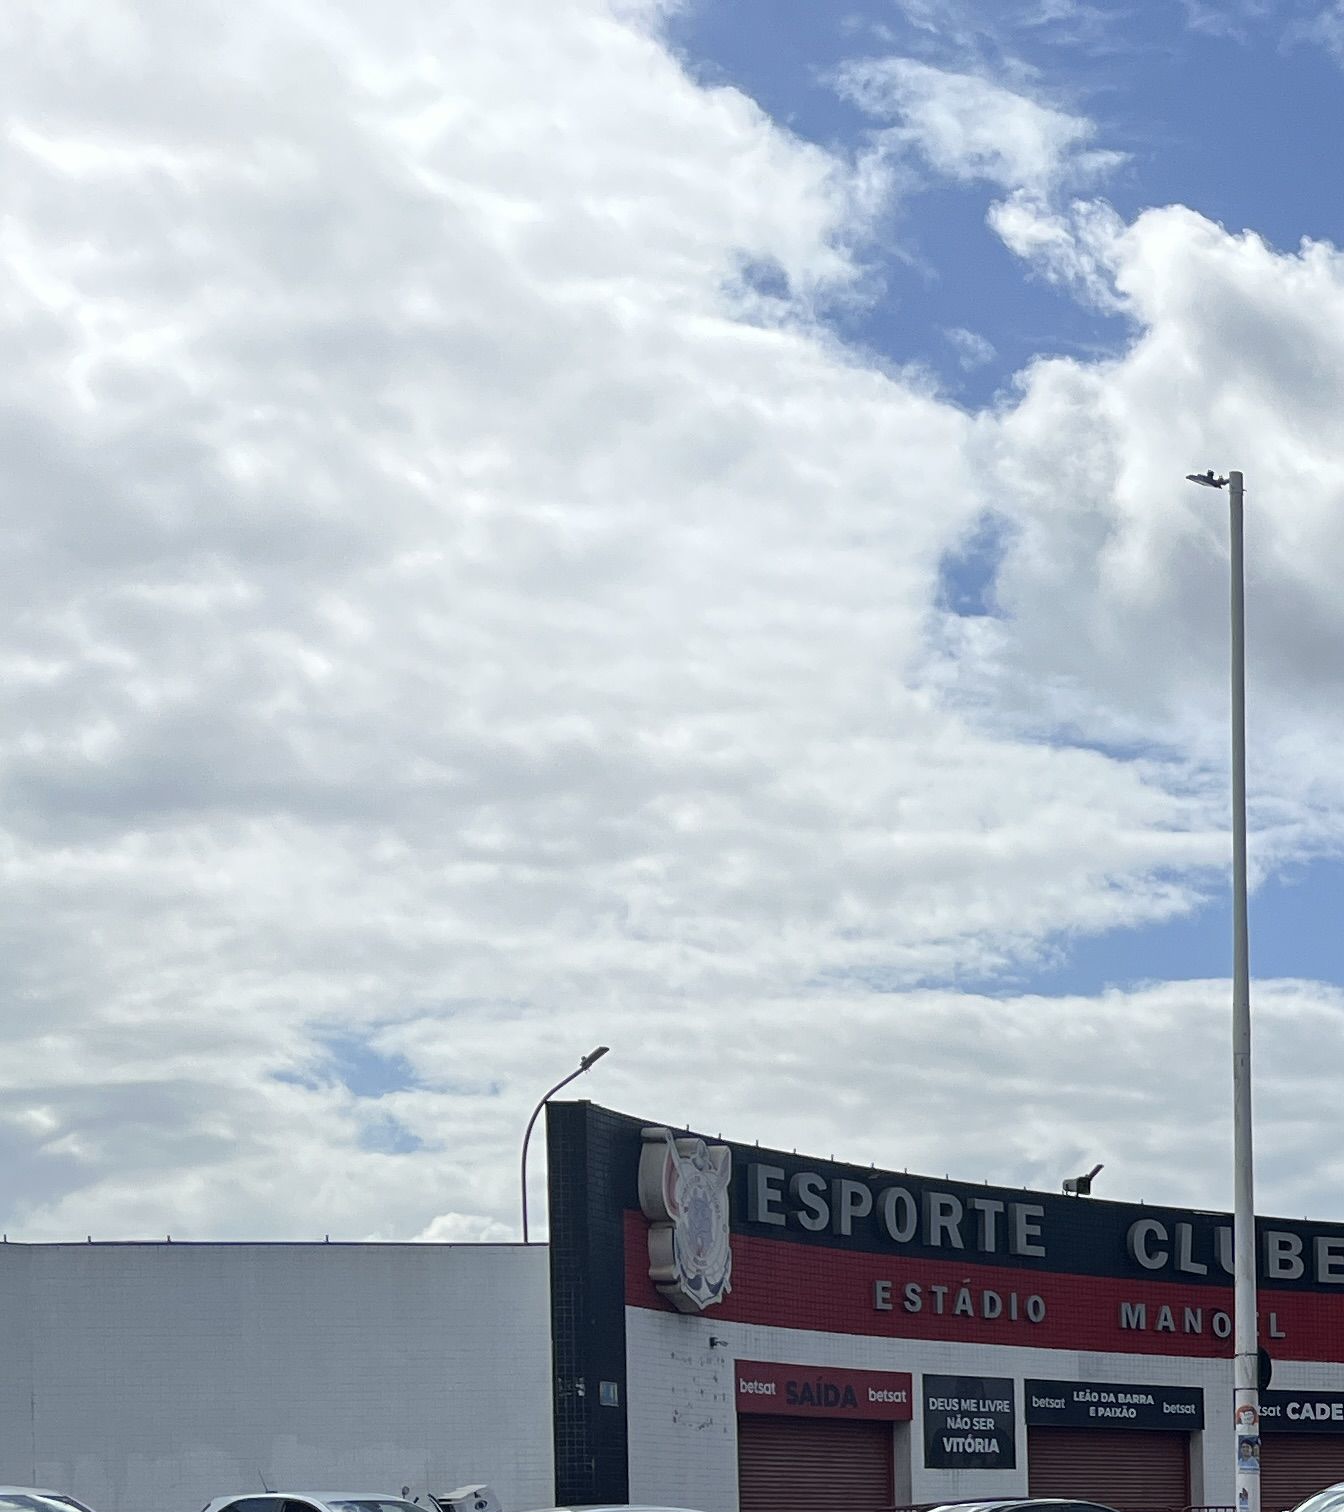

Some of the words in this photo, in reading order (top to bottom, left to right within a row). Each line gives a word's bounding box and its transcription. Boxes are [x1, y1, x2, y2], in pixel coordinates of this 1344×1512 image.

[748, 1162, 1046, 1257] ESPORTE
[874, 1278, 1046, 1323] ESTÁDIO
[1120, 1302, 1286, 1339] MANOL
[739, 1378, 776, 1396] betsat
[786, 1376, 859, 1409] SAÍDA
[868, 1387, 907, 1403] betsat
[1073, 1389, 1099, 1402] LEÃO
[1100, 1393, 1116, 1403] DA
[1118, 1393, 1155, 1405] BARRA
[929, 1397, 960, 1411] DEUS
[961, 1398, 978, 1412] ME
[979, 1398, 1011, 1413] LIVRE
[1032, 1395, 1066, 1409] betsat
[1163, 1402, 1196, 1415] betsat
[1089, 1407, 1096, 1417] E
[1098, 1405, 1137, 1419] PAIXÃO
[1257, 1404, 1281, 1417] tsat
[946, 1414, 971, 1430] NÃO
[972, 1417, 995, 1430] SER
[942, 1434, 1000, 1454] VITÓRIA
